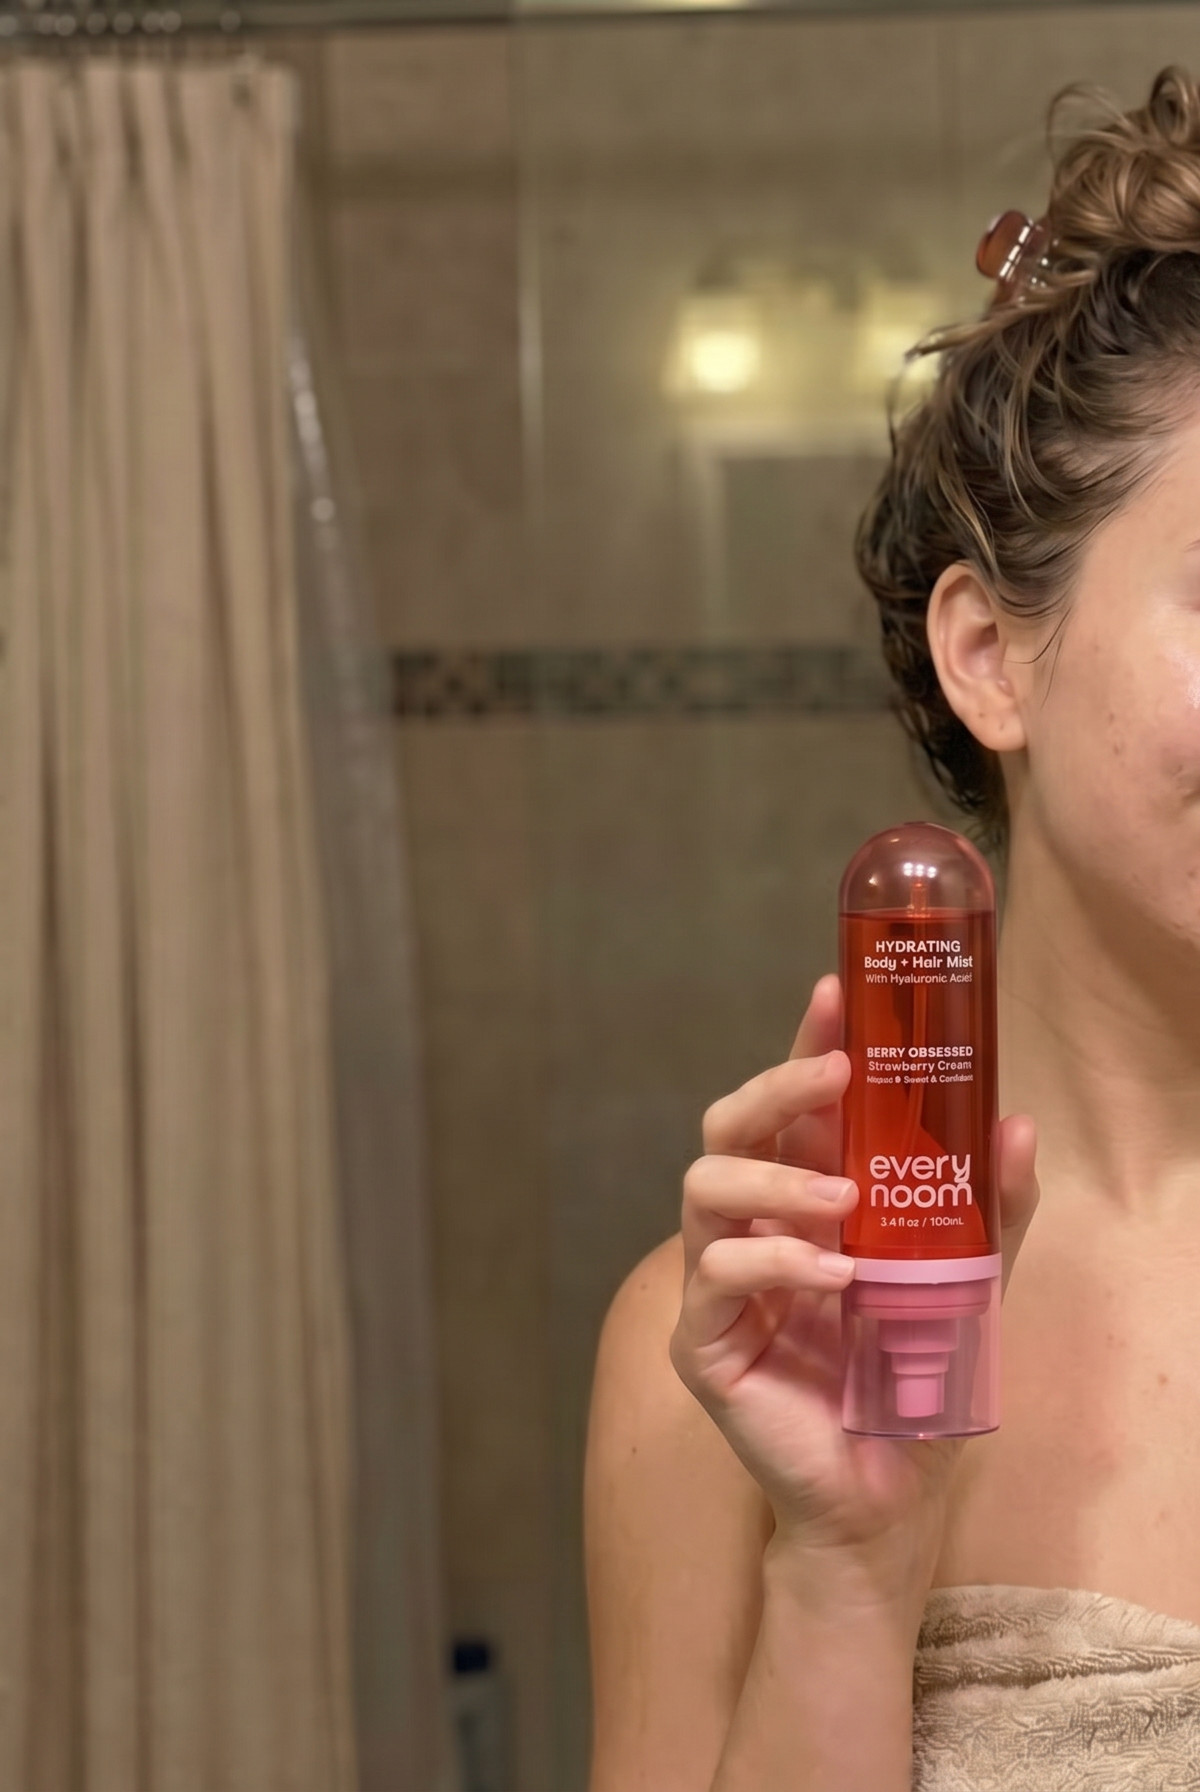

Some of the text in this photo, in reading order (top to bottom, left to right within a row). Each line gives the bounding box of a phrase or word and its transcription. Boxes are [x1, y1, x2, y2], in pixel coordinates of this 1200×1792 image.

[876, 940, 961, 953] HYDRATING
[864, 956, 973, 971] Body + Hair Mist
[866, 974, 887, 983] With
[890, 974, 947, 986] Hyaluronic
[867, 1046, 973, 1058] BERRY OBSESSED
[868, 1061, 935, 1073] Strawberry
[870, 1154, 971, 1183] every
[870, 1182, 972, 1208] noom
[881, 1217, 896, 1227] 3.4
[899, 1217, 904, 1226] fl
[907, 1219, 919, 1227] oz
